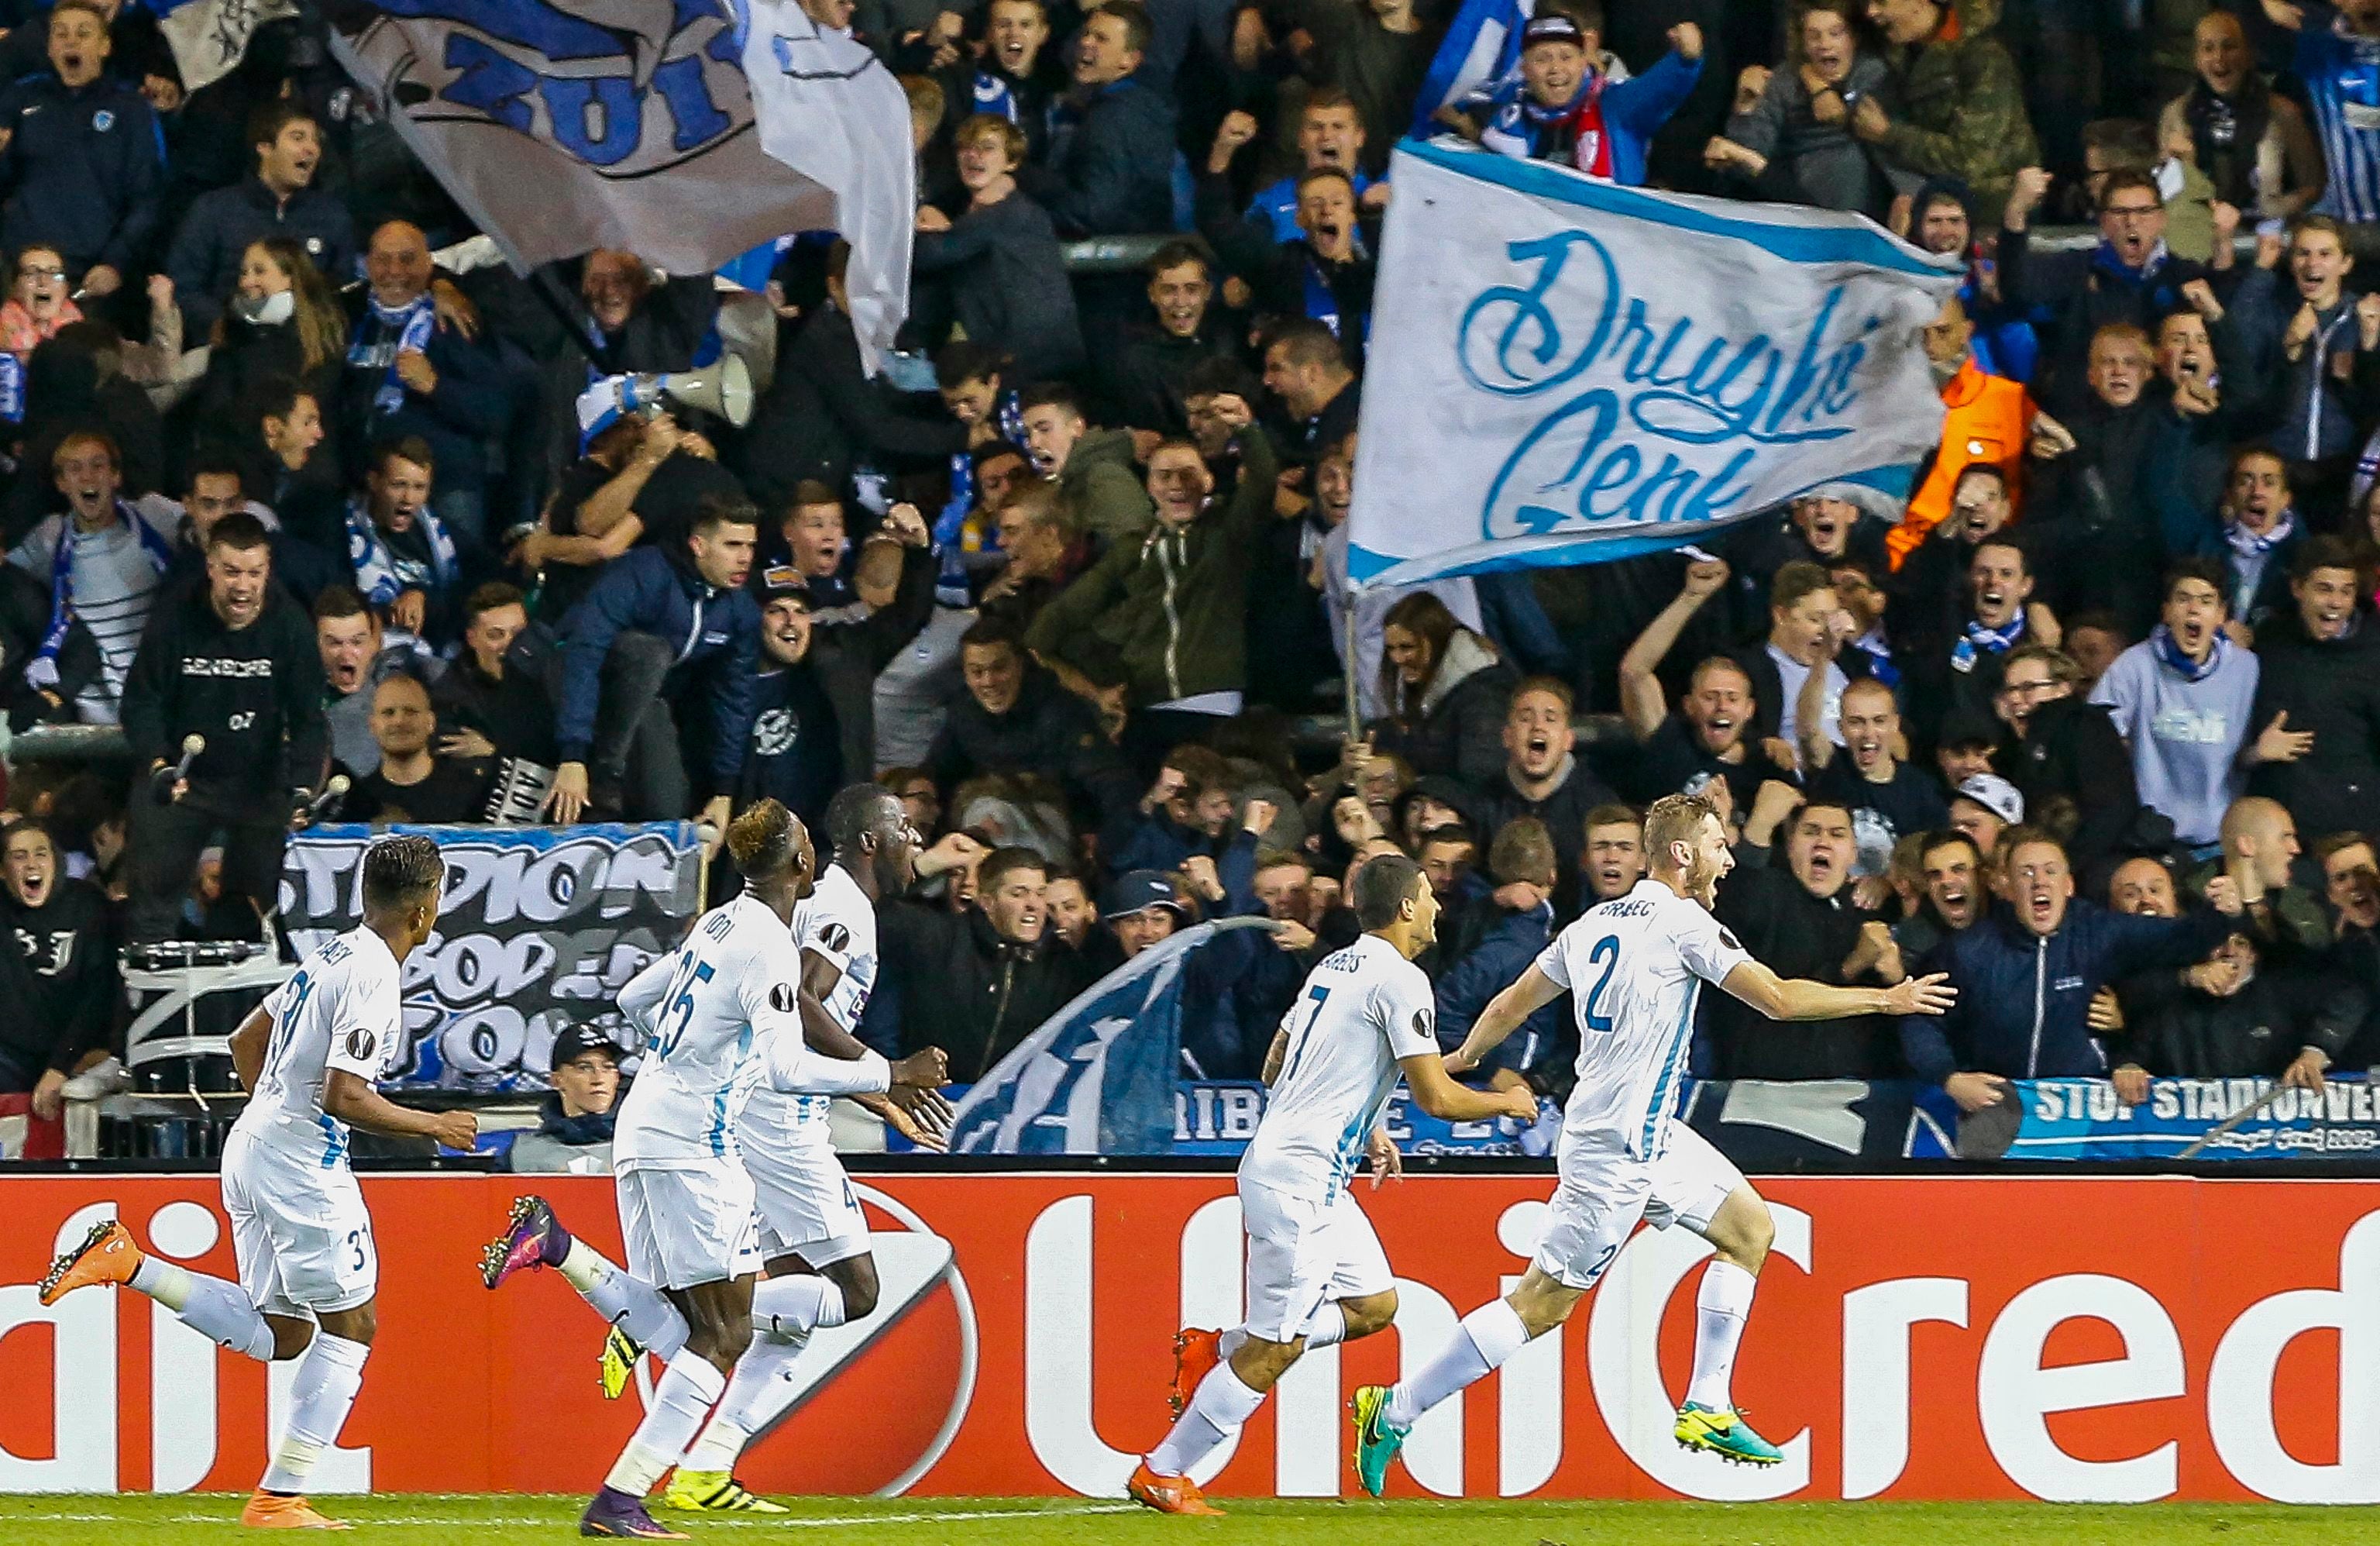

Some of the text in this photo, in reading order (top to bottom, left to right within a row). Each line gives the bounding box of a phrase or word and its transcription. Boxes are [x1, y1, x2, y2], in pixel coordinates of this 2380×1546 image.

[648, 950, 717, 1062] 25
[1584, 934, 1620, 1032] 2
[1288, 984, 1332, 1082] 7
[2034, 1078, 2380, 1121] STO STADIONVE
[841, 1177, 859, 1214] 4
[1586, 1243, 1617, 1277] 2
